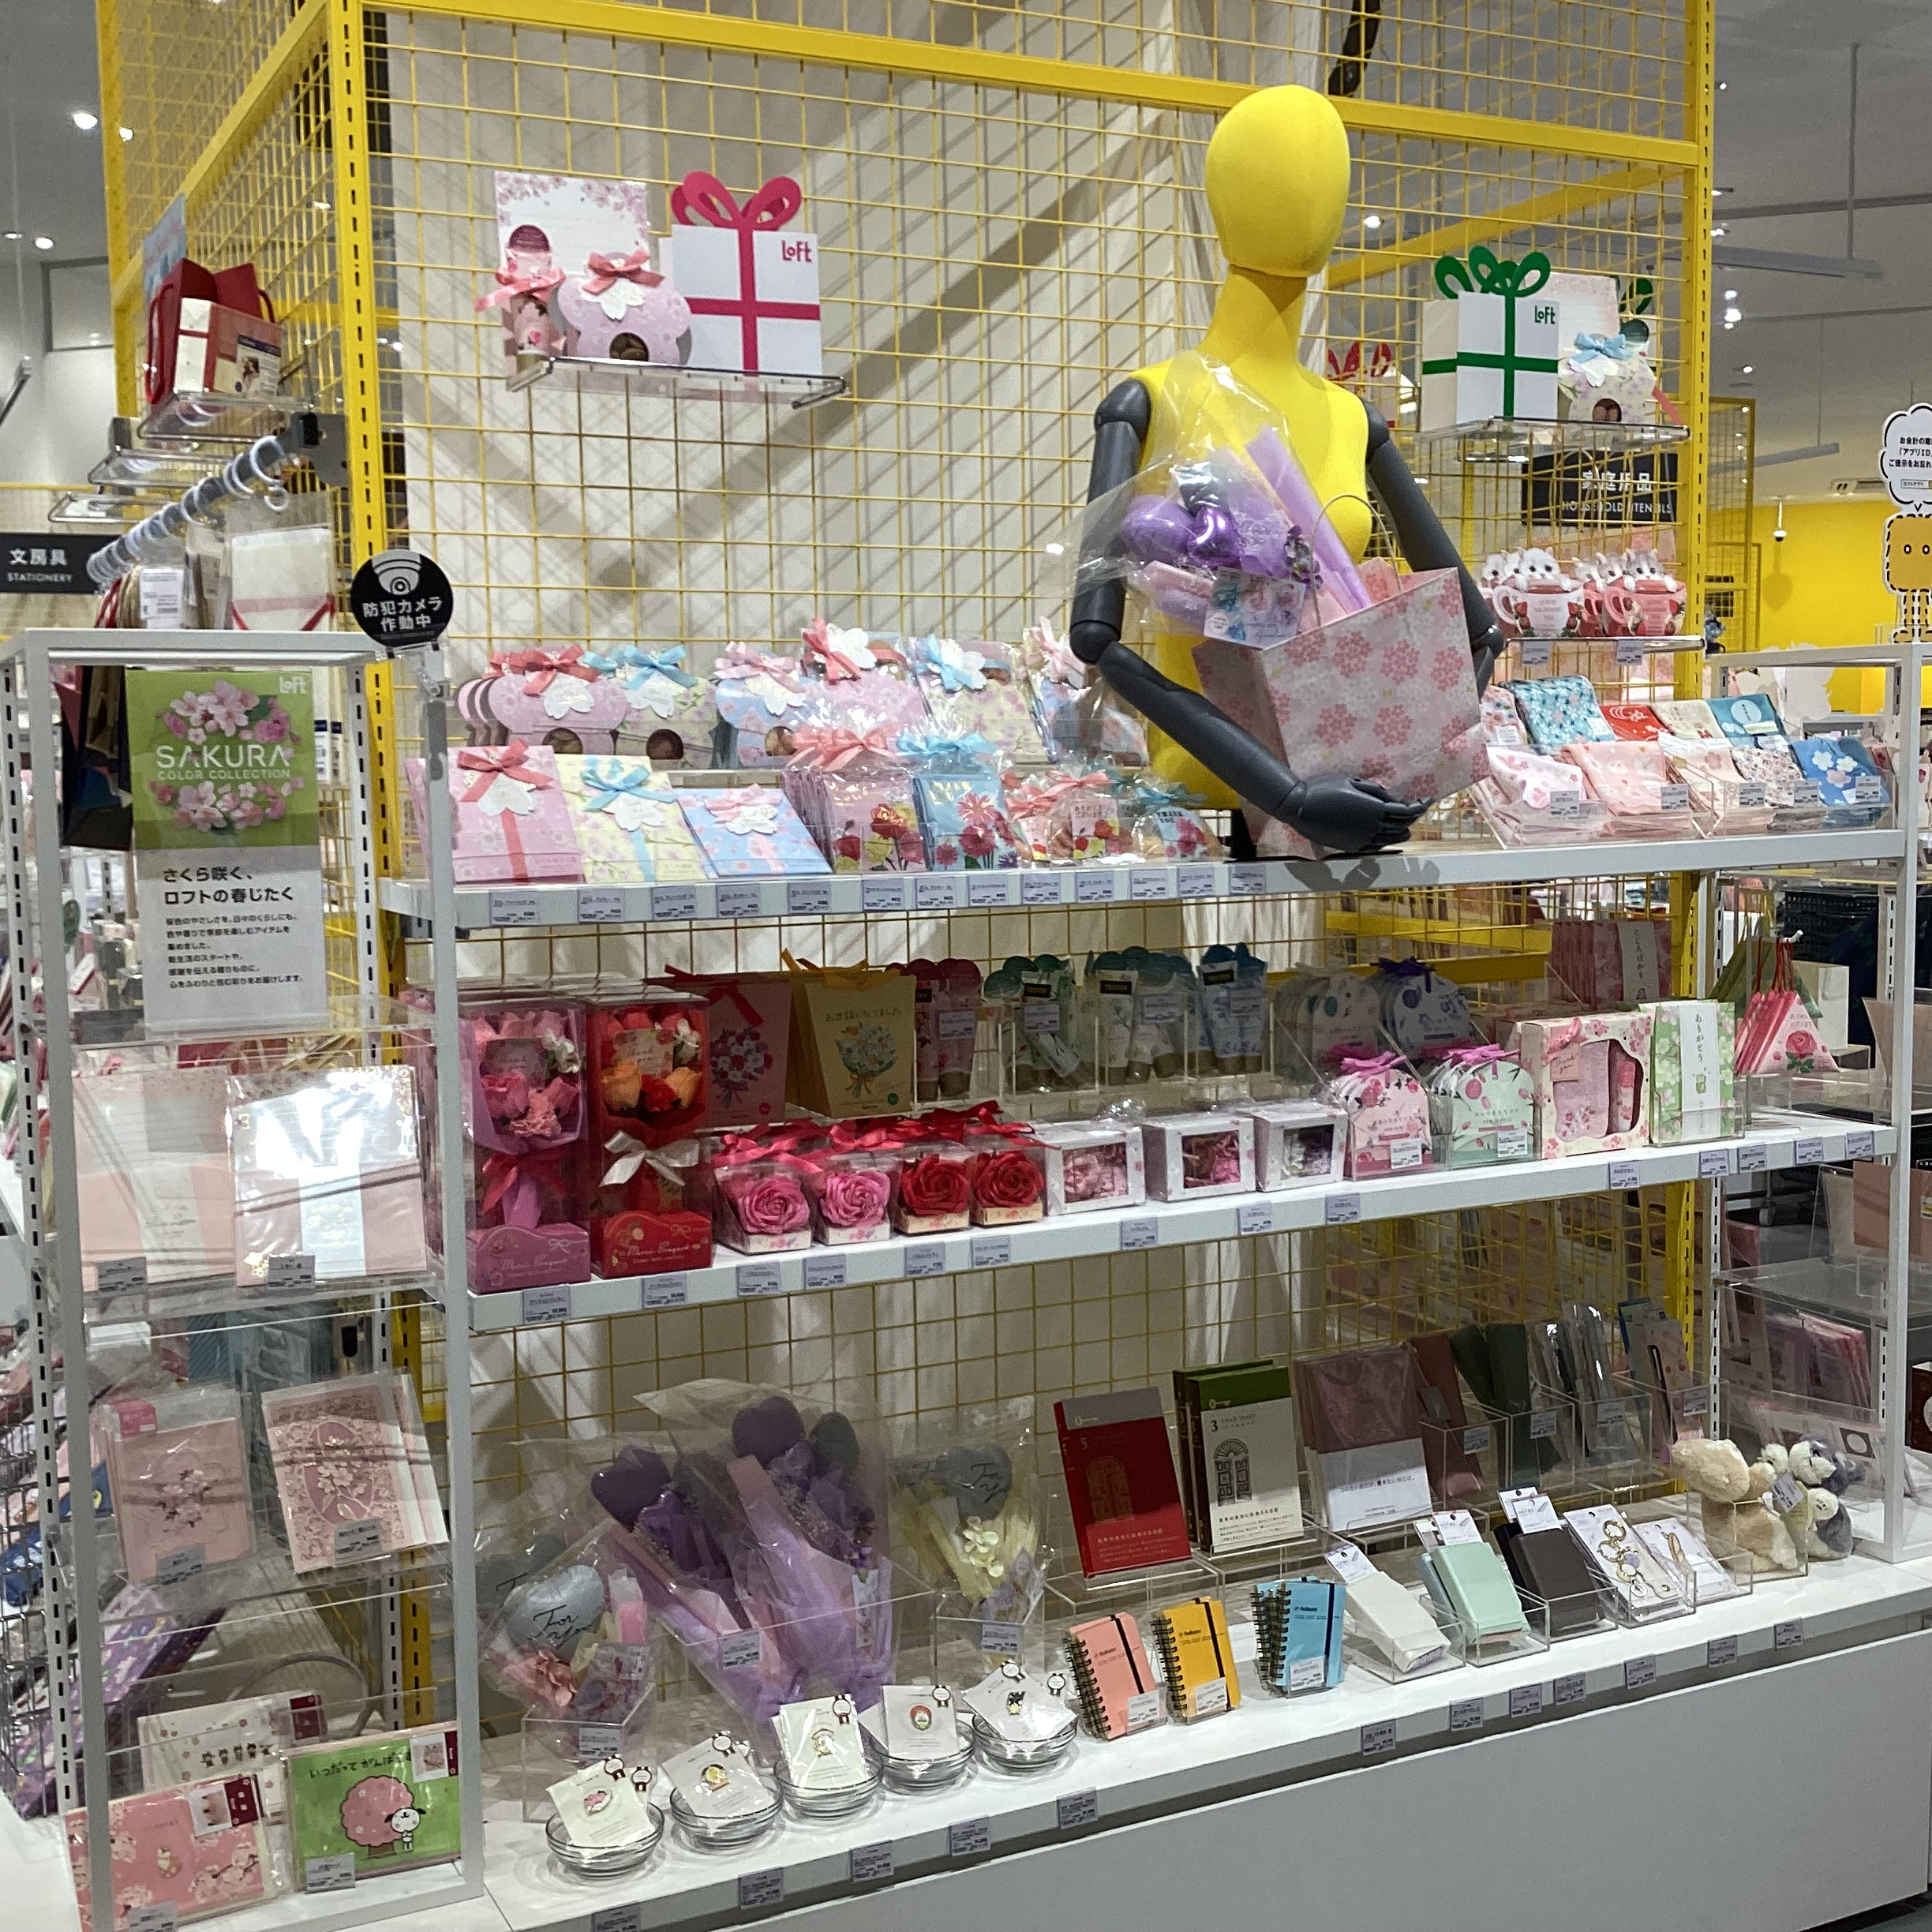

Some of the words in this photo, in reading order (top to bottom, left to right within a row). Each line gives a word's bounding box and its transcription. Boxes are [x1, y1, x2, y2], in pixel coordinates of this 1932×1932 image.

[1900, 436, 1932, 445] お会計の際
[9, 548, 68, 567] 文房具
[6, 572, 73, 583] STATIONERY
[362, 597, 442, 618] 防犯カメラ
[380, 613, 432, 632] 作動中
[157, 745, 290, 769] SAKURA
[159, 770, 203, 781] COLOR
[208, 769, 290, 780] COLLECTION
[163, 866, 253, 883] さくら咲く、
[164, 886, 294, 904] ロフトの春じたく
[1695, 1013, 1705, 1063] ありがとう
[1211, 1420, 1219, 1432] 3
